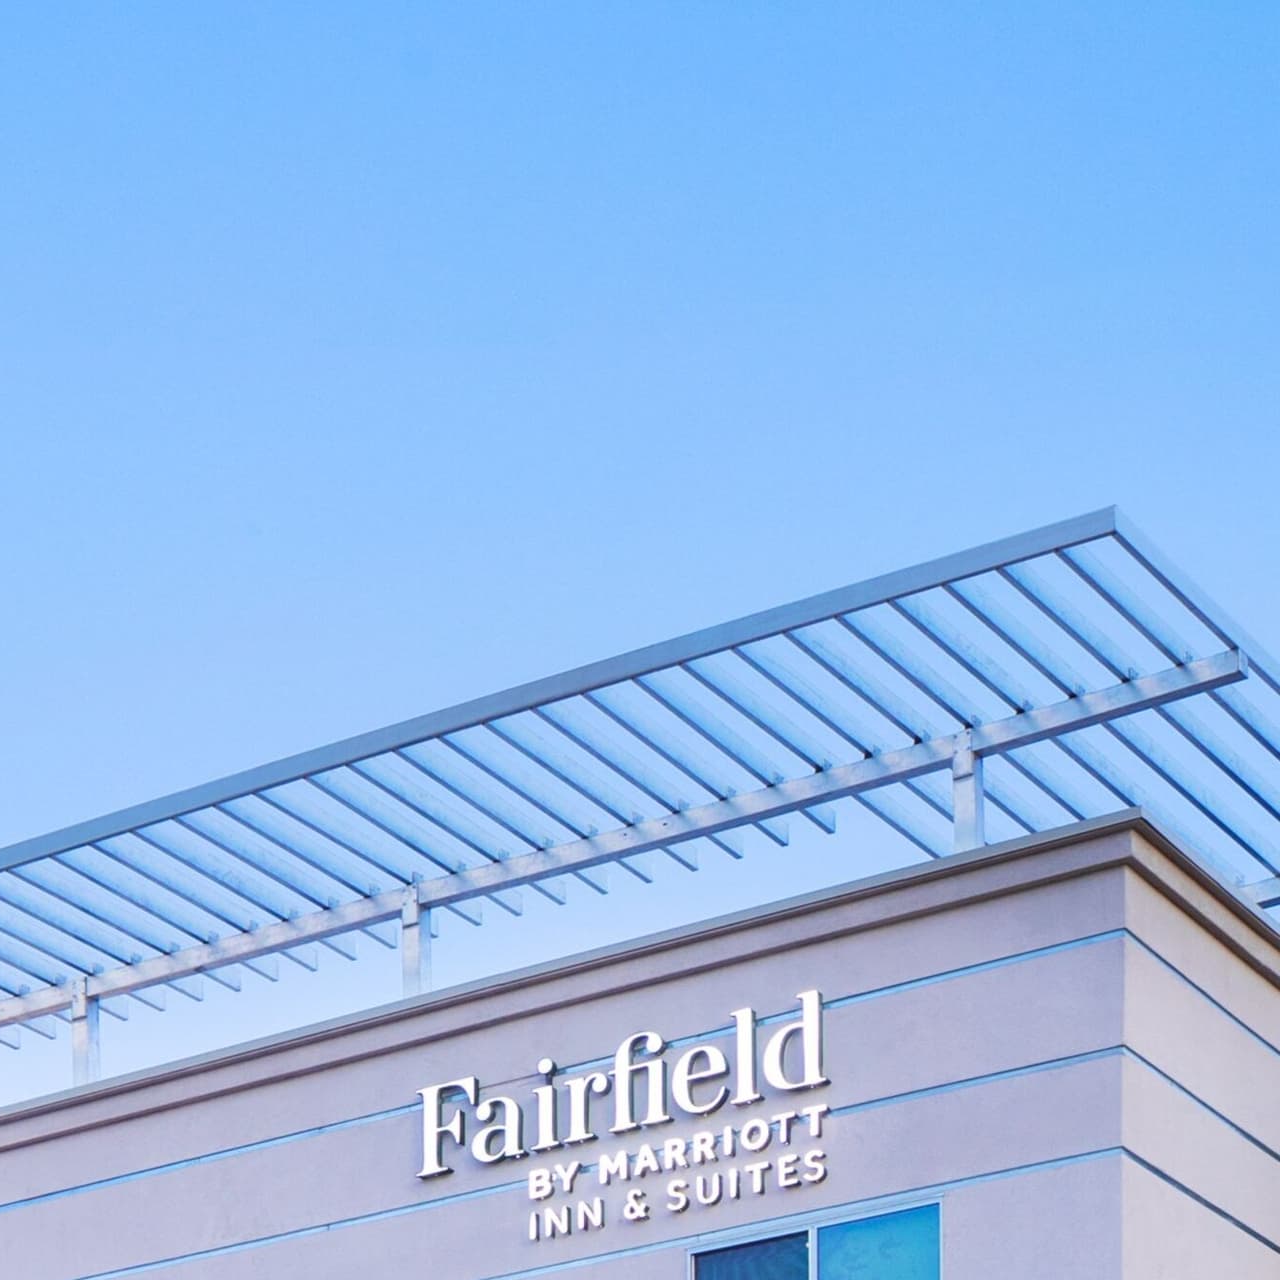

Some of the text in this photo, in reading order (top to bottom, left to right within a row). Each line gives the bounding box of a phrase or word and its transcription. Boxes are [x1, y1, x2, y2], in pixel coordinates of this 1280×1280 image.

[415, 988, 829, 1179] Fairfield
[528, 1102, 829, 1201] BY MARRIOTT
[528, 1148, 827, 1242] INN & SUITES
